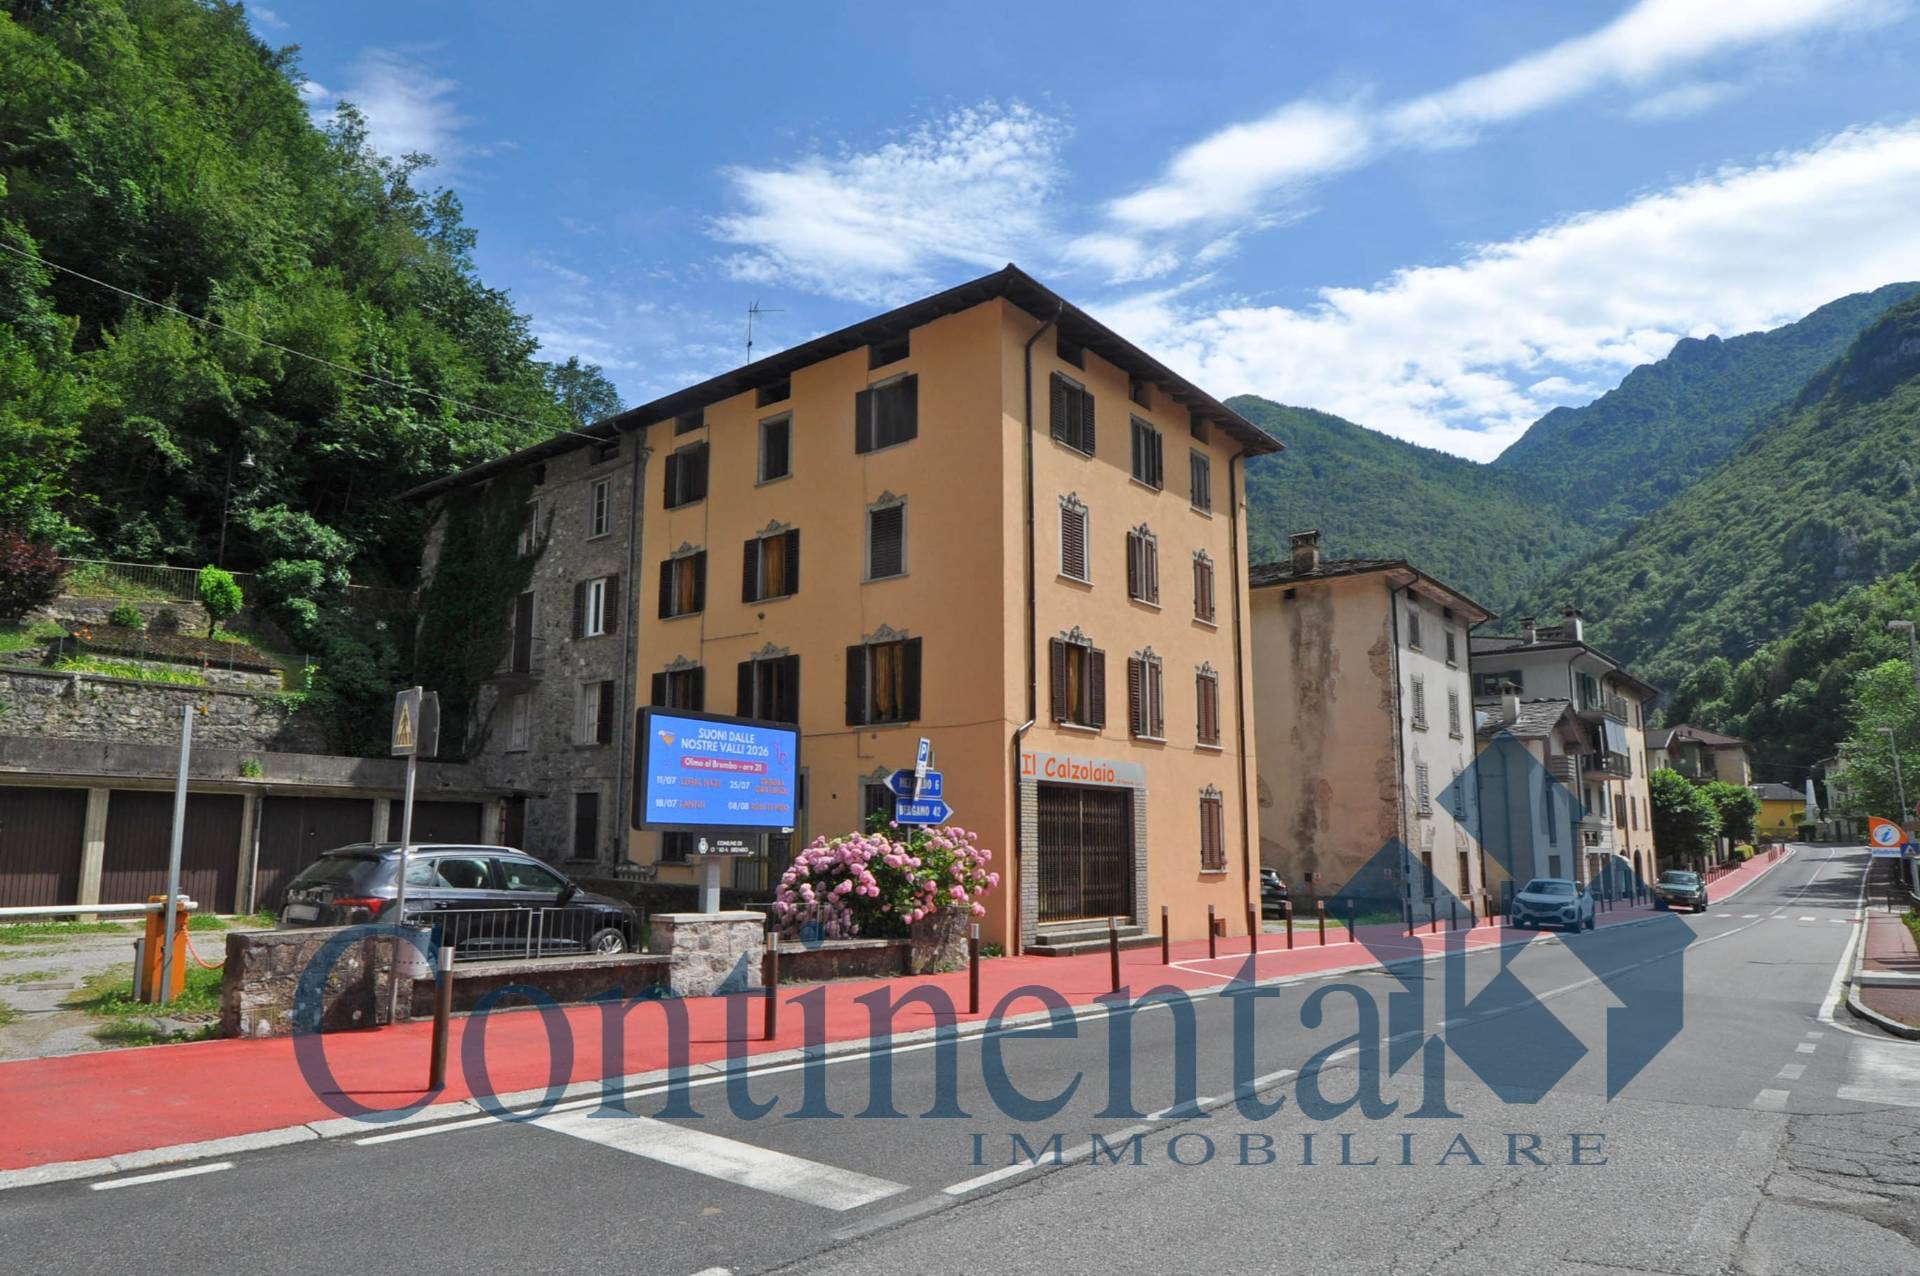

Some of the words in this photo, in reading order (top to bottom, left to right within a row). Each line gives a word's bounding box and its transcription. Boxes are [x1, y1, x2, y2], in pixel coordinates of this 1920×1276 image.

[698, 727, 727, 741] SUONI
[728, 731, 755, 744] DALLE
[681, 738, 718, 752] NOSTRE
[719, 742, 744, 754] VALLI
[746, 744, 769, 757] 2026
[1022, 753, 1037, 775] Il
[1044, 755, 1115, 783] Calzolaio
[934, 779, 940, 790] 6
[899, 805, 930, 817] BERGAMO
